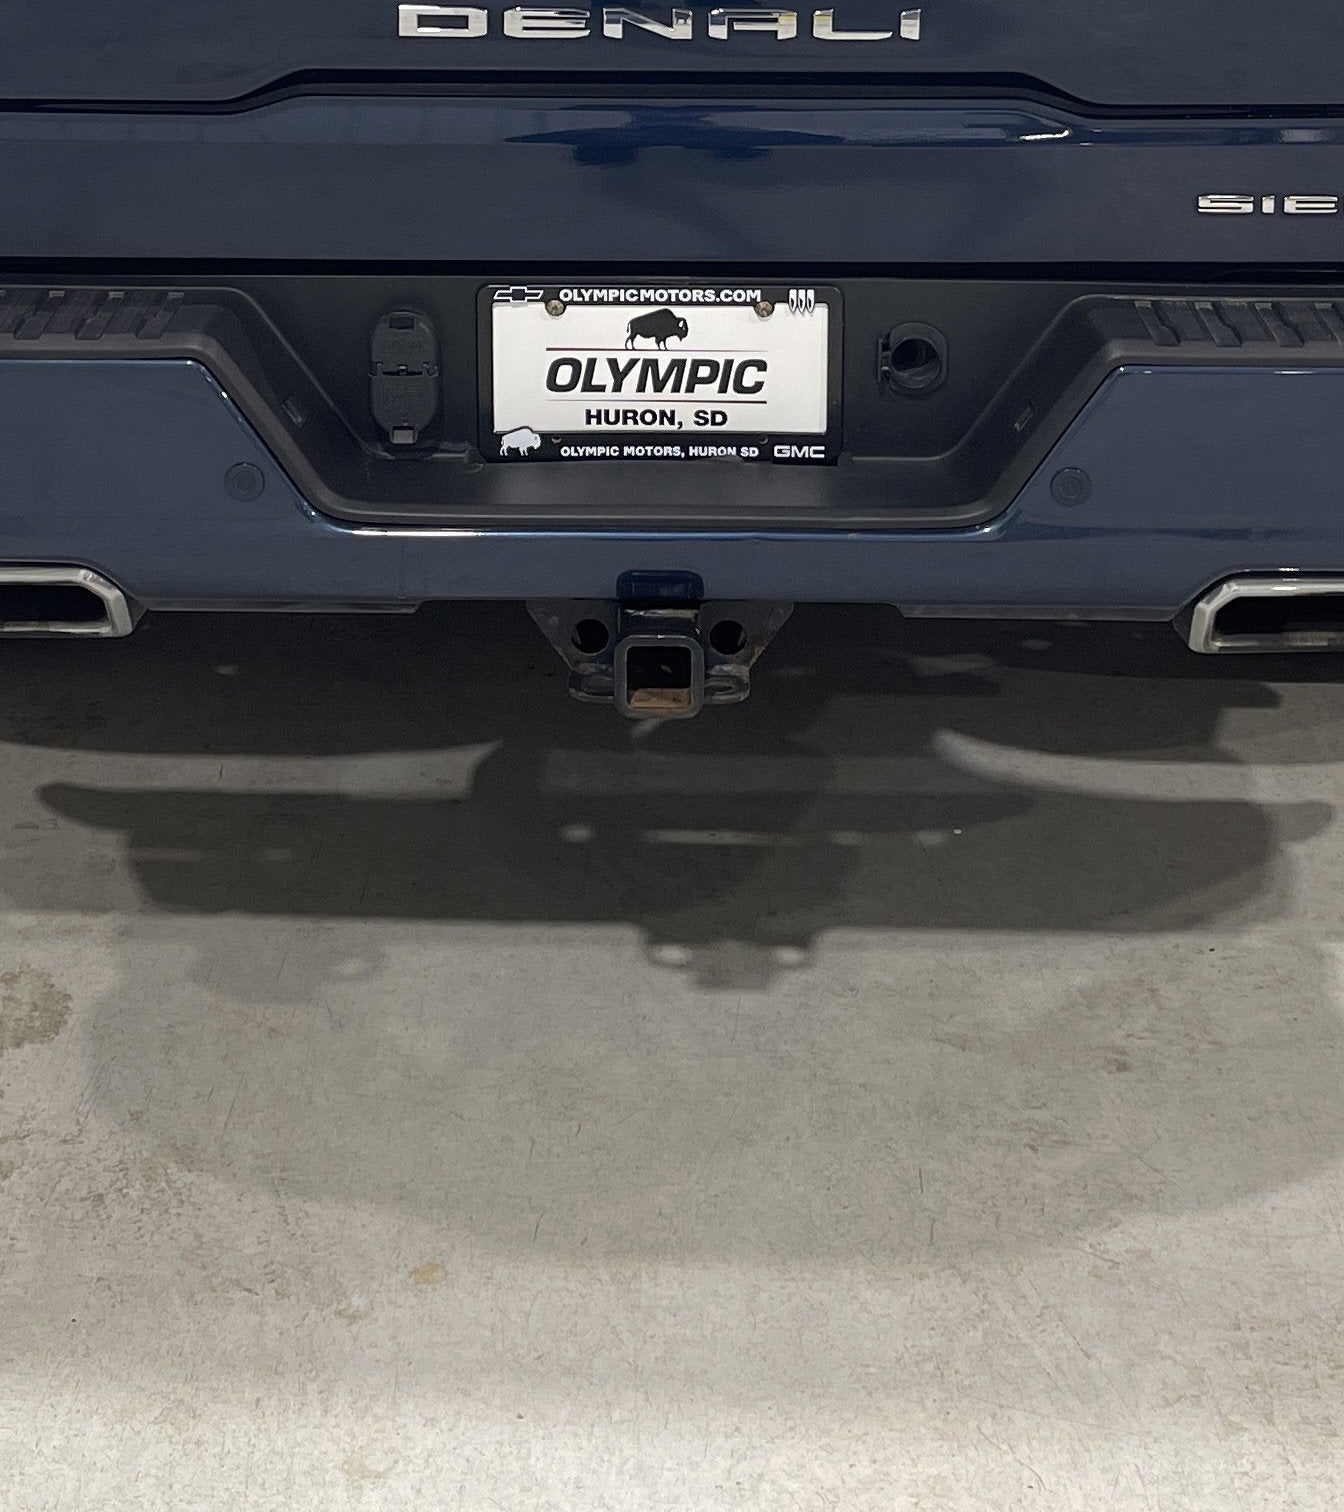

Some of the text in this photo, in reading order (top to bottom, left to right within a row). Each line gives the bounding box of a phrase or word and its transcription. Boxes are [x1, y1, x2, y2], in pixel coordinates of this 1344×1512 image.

[398, 5, 921, 40] DENALI
[559, 289, 761, 303] OLYMPICMOTORS.COM
[546, 358, 767, 394] OLYMPIC
[584, 409, 727, 431] HURON, SD
[561, 446, 758, 458] OLYMPIC MOTORS, HURON SD
[774, 446, 825, 458] GMC
